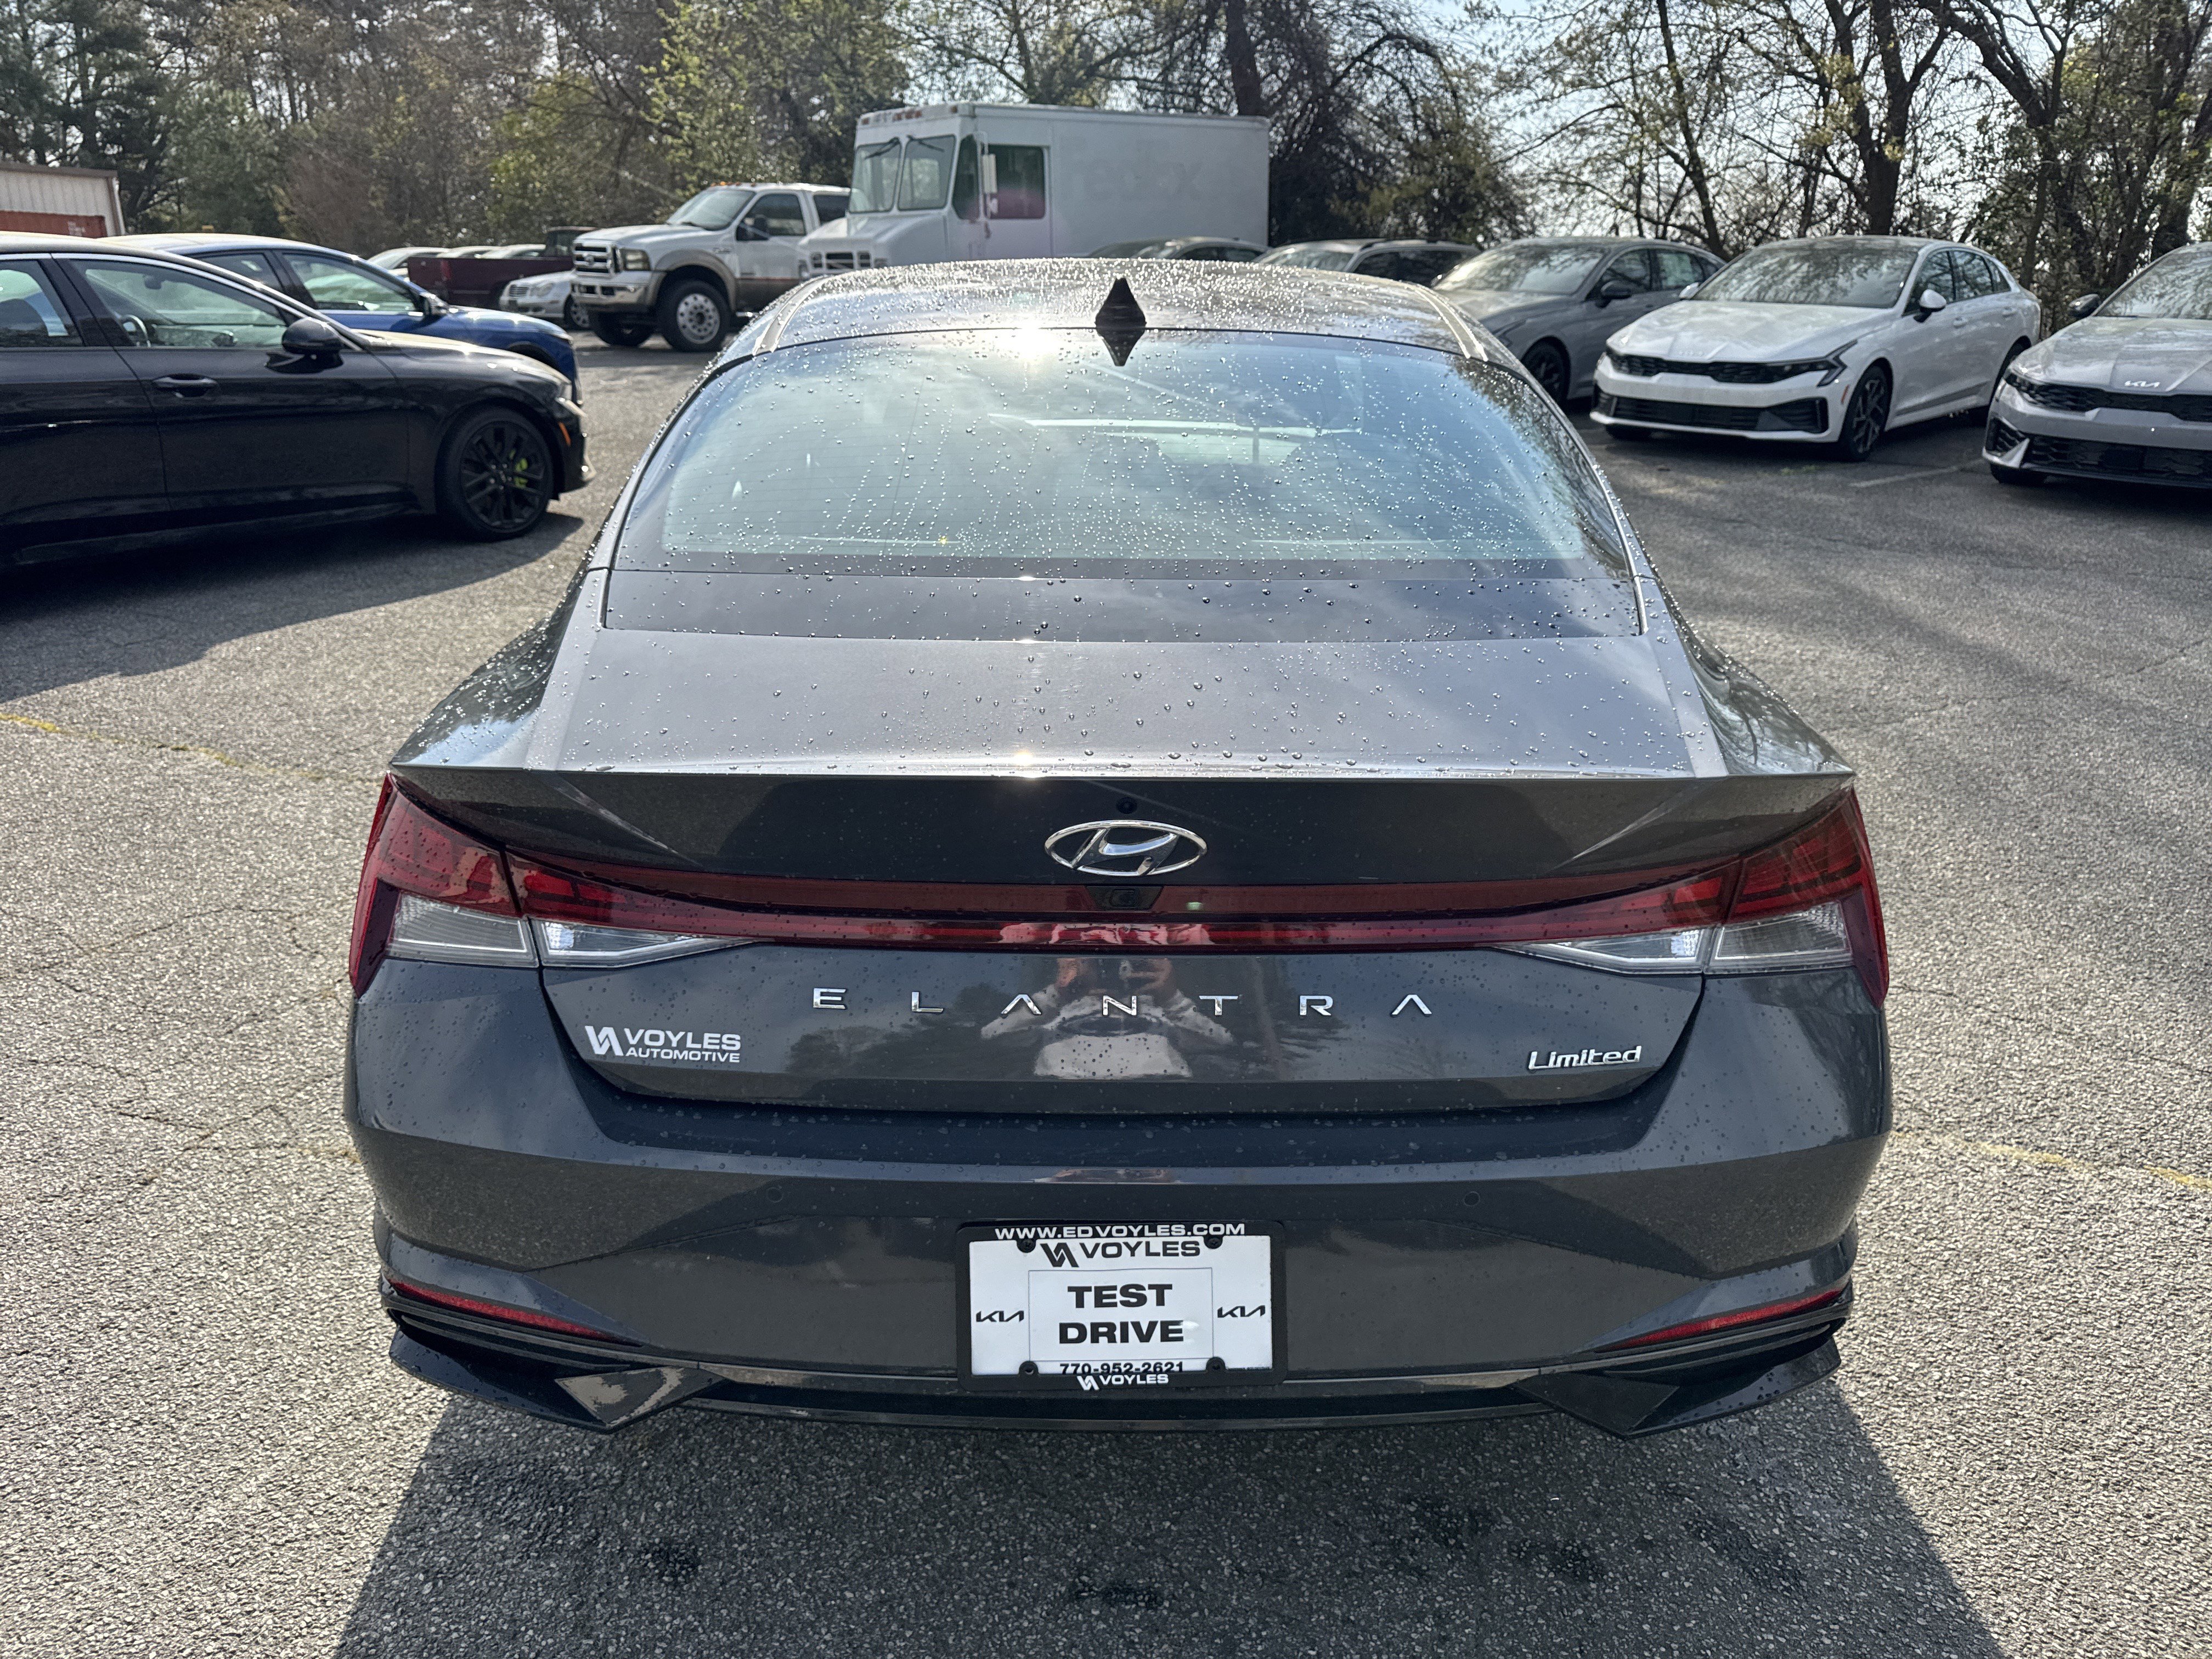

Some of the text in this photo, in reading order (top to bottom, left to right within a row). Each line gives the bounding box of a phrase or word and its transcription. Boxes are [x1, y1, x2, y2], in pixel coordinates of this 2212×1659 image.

[812, 988, 1432, 1017] ELANTRA
[624, 1027, 741, 1051] VOYLES
[625, 1046, 740, 1063] AUTOMOTIVE
[1528, 1045, 1642, 1070] Limited
[1079, 1240, 1200, 1259] VOYLES
[1067, 1283, 1173, 1308] TEST
[1059, 1319, 1184, 1344] DRIVE
[1059, 1361, 1183, 1375] 770-952-2621
[1099, 1373, 1169, 1385] VOYLES
